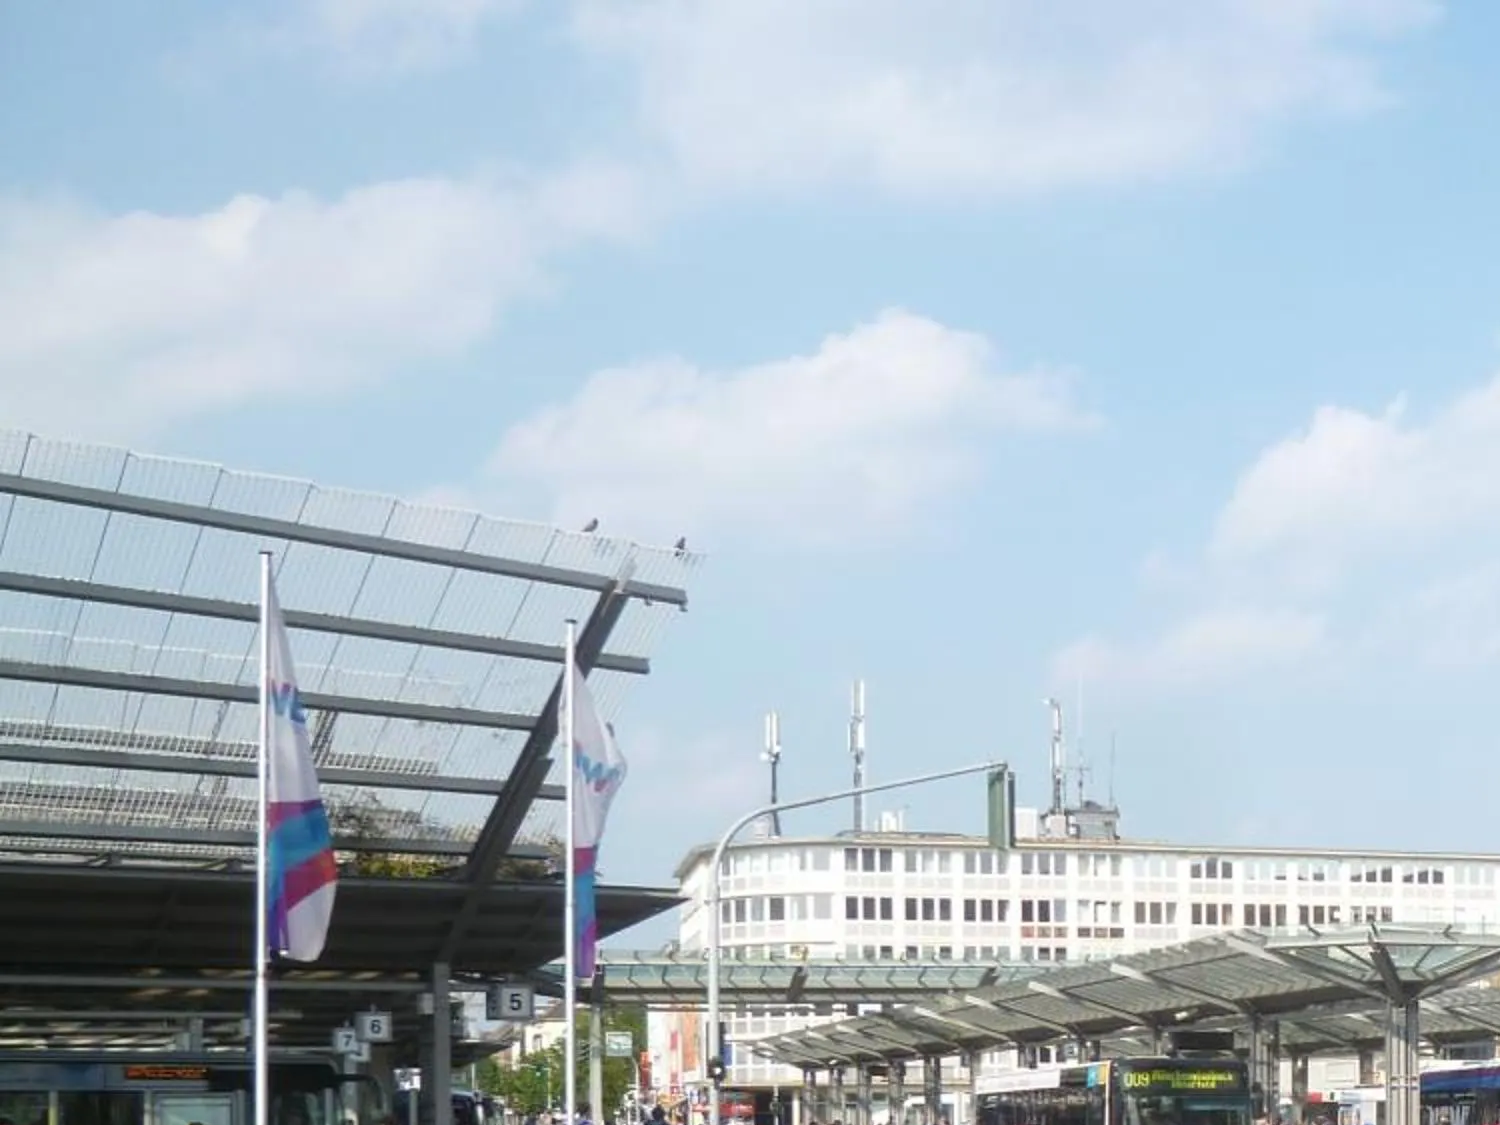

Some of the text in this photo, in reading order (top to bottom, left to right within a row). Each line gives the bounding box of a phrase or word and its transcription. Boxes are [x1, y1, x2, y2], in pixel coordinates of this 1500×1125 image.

[509, 993, 522, 1011] 5
[370, 1019, 382, 1034] 6
[342, 1034, 353, 1048] 7
[1123, 1071, 1150, 1088] 009
